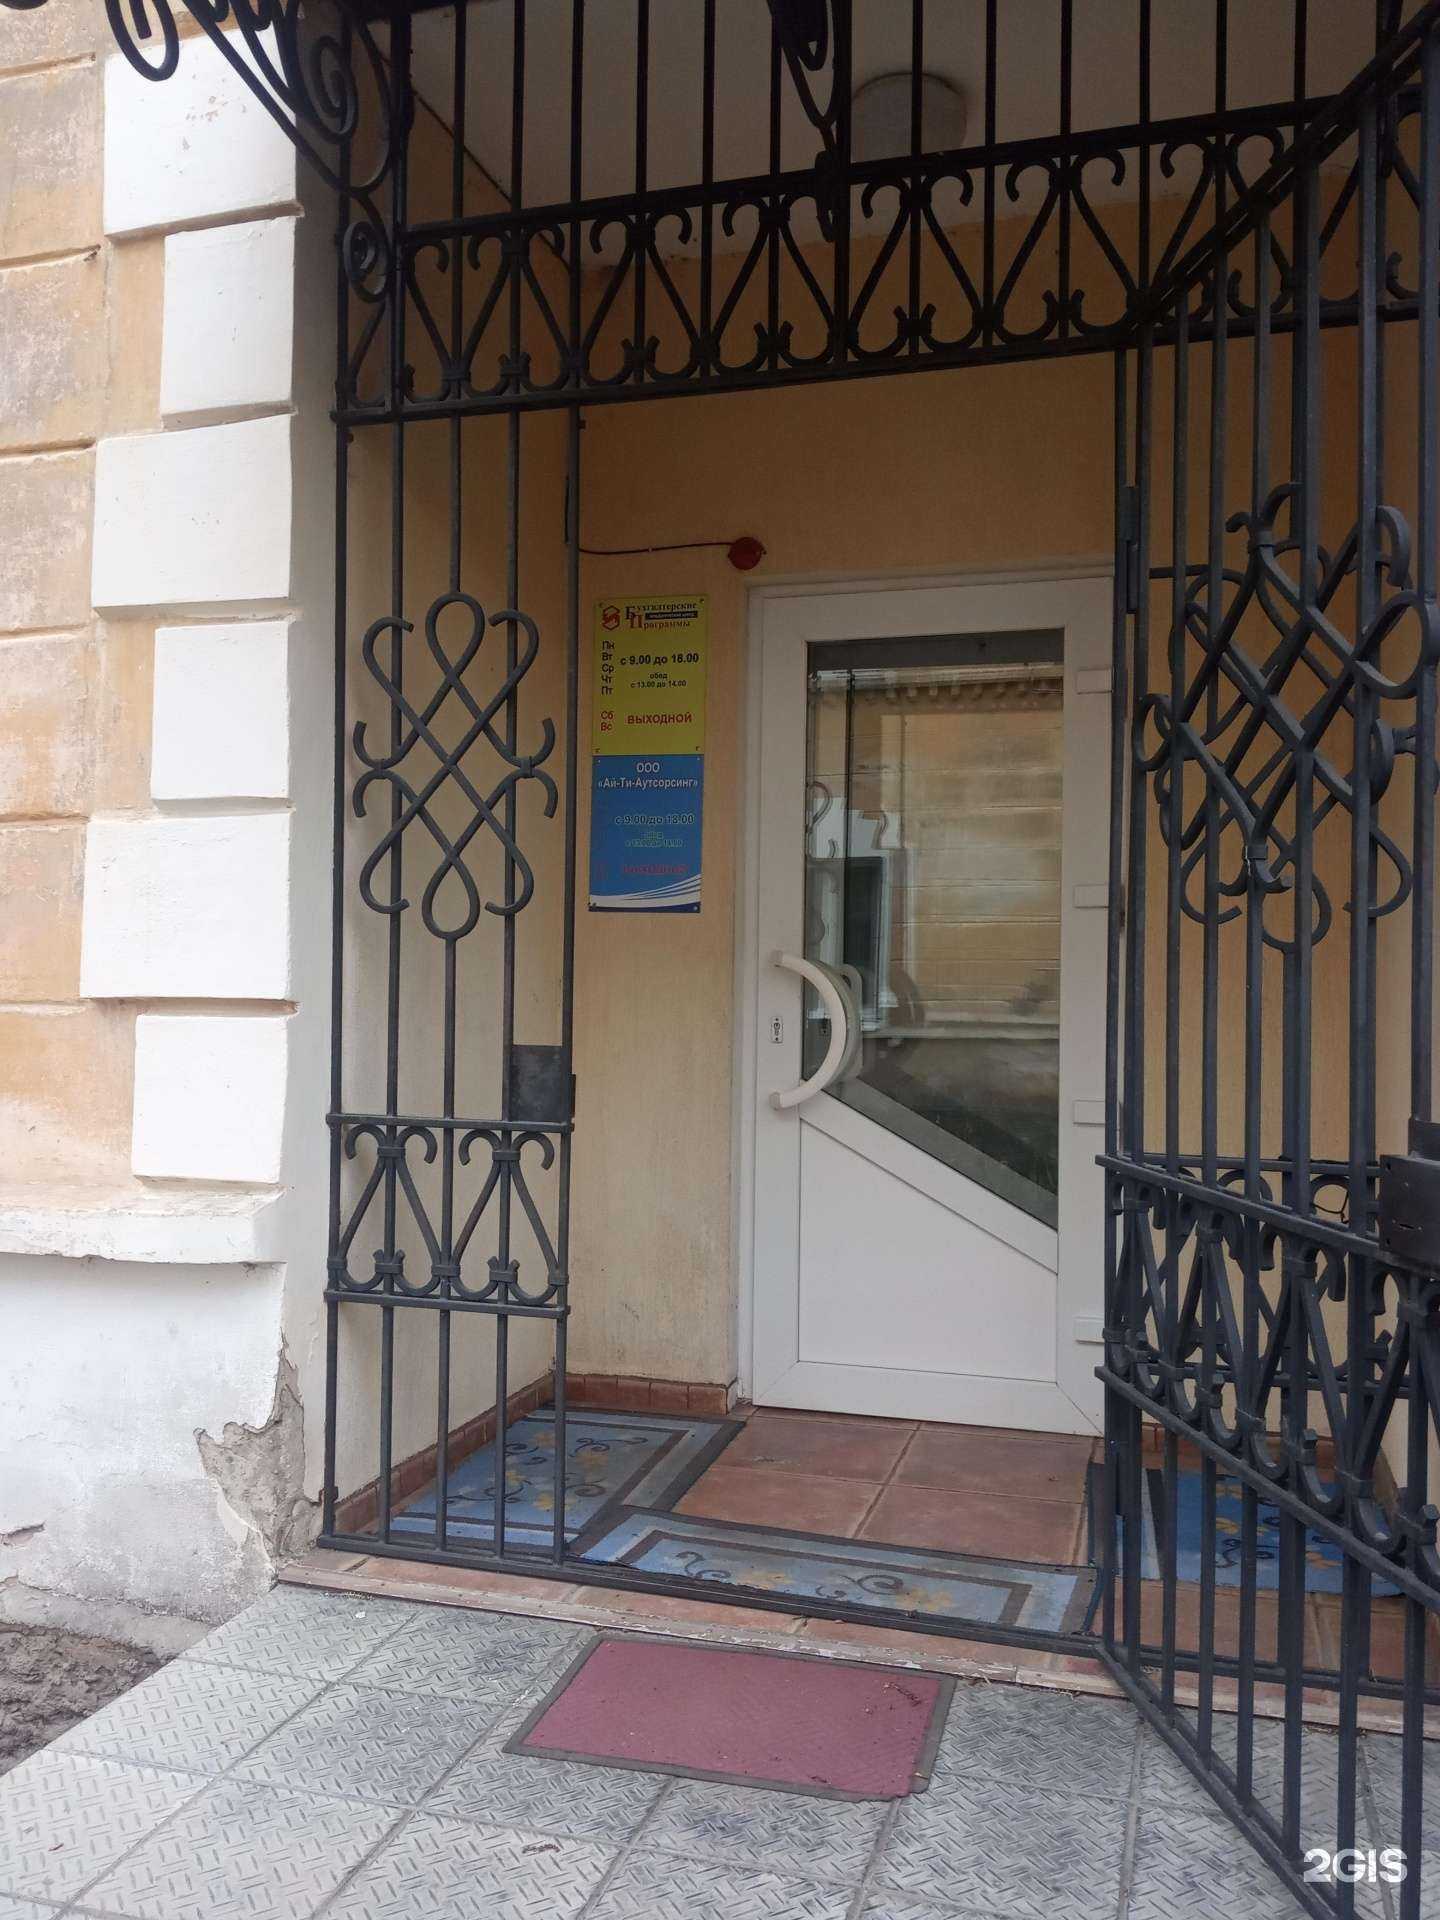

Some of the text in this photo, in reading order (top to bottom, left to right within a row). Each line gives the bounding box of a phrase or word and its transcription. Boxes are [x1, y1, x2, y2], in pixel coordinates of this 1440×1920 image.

[630, 612, 690, 630] Программы
[602, 640, 615, 650] Пн
[602, 652, 613, 661] Вт
[629, 655, 651, 665] 9.00
[653, 656, 668, 665] до
[601, 664, 615, 674] Ср
[601, 675, 612, 684] Чт
[601, 686, 613, 695] Пт
[600, 711, 614, 720] Сб
[627, 711, 693, 725] ВЫХОДНОЙ
[600, 722, 612, 731] Вс
[636, 762, 660, 773] ООО
